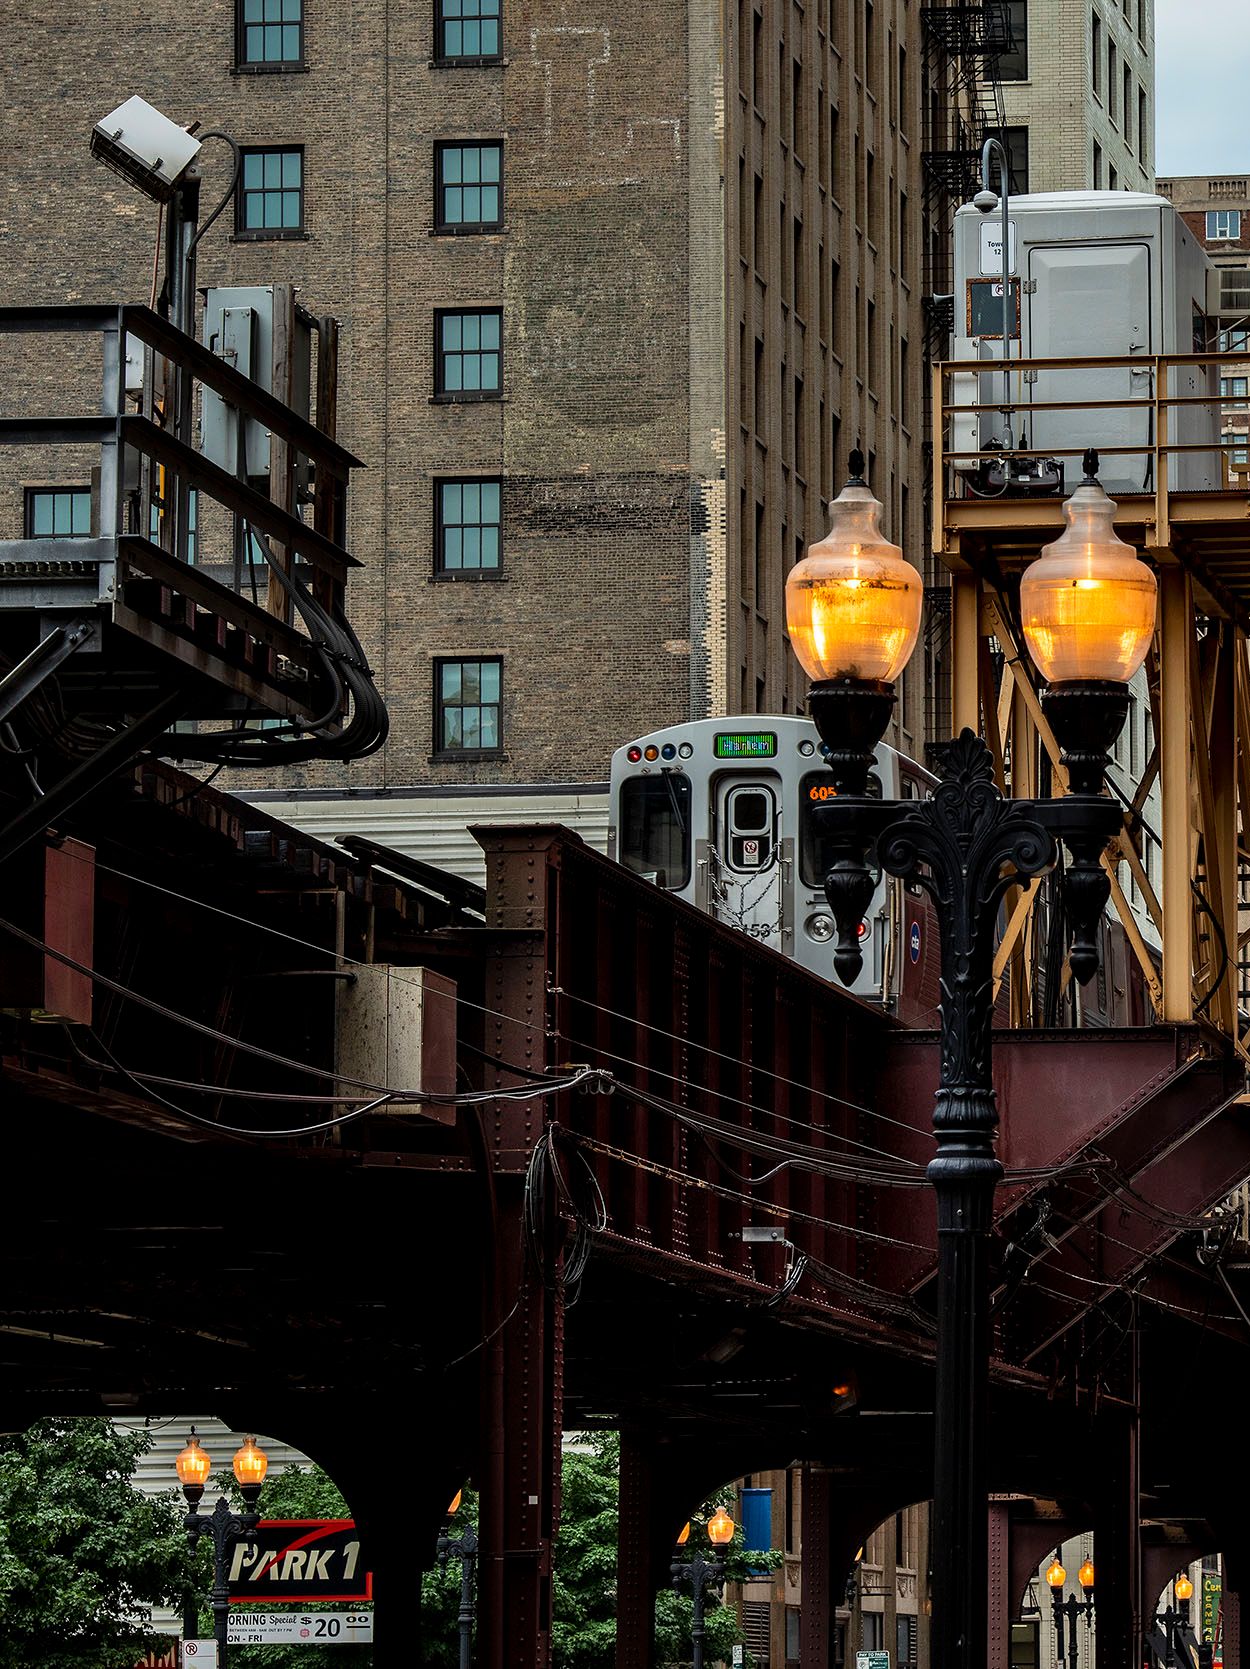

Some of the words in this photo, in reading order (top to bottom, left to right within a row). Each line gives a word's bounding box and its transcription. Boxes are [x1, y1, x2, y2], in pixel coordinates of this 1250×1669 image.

[723, 740, 770, 751] Harlem
[228, 1543, 336, 1581] PARK
[342, 1541, 360, 1580] 1
[228, 1614, 266, 1626] ORNING
[269, 1615, 298, 1626] Special
[227, 1634, 241, 1643] ON
[248, 1634, 263, 1643] FRI
